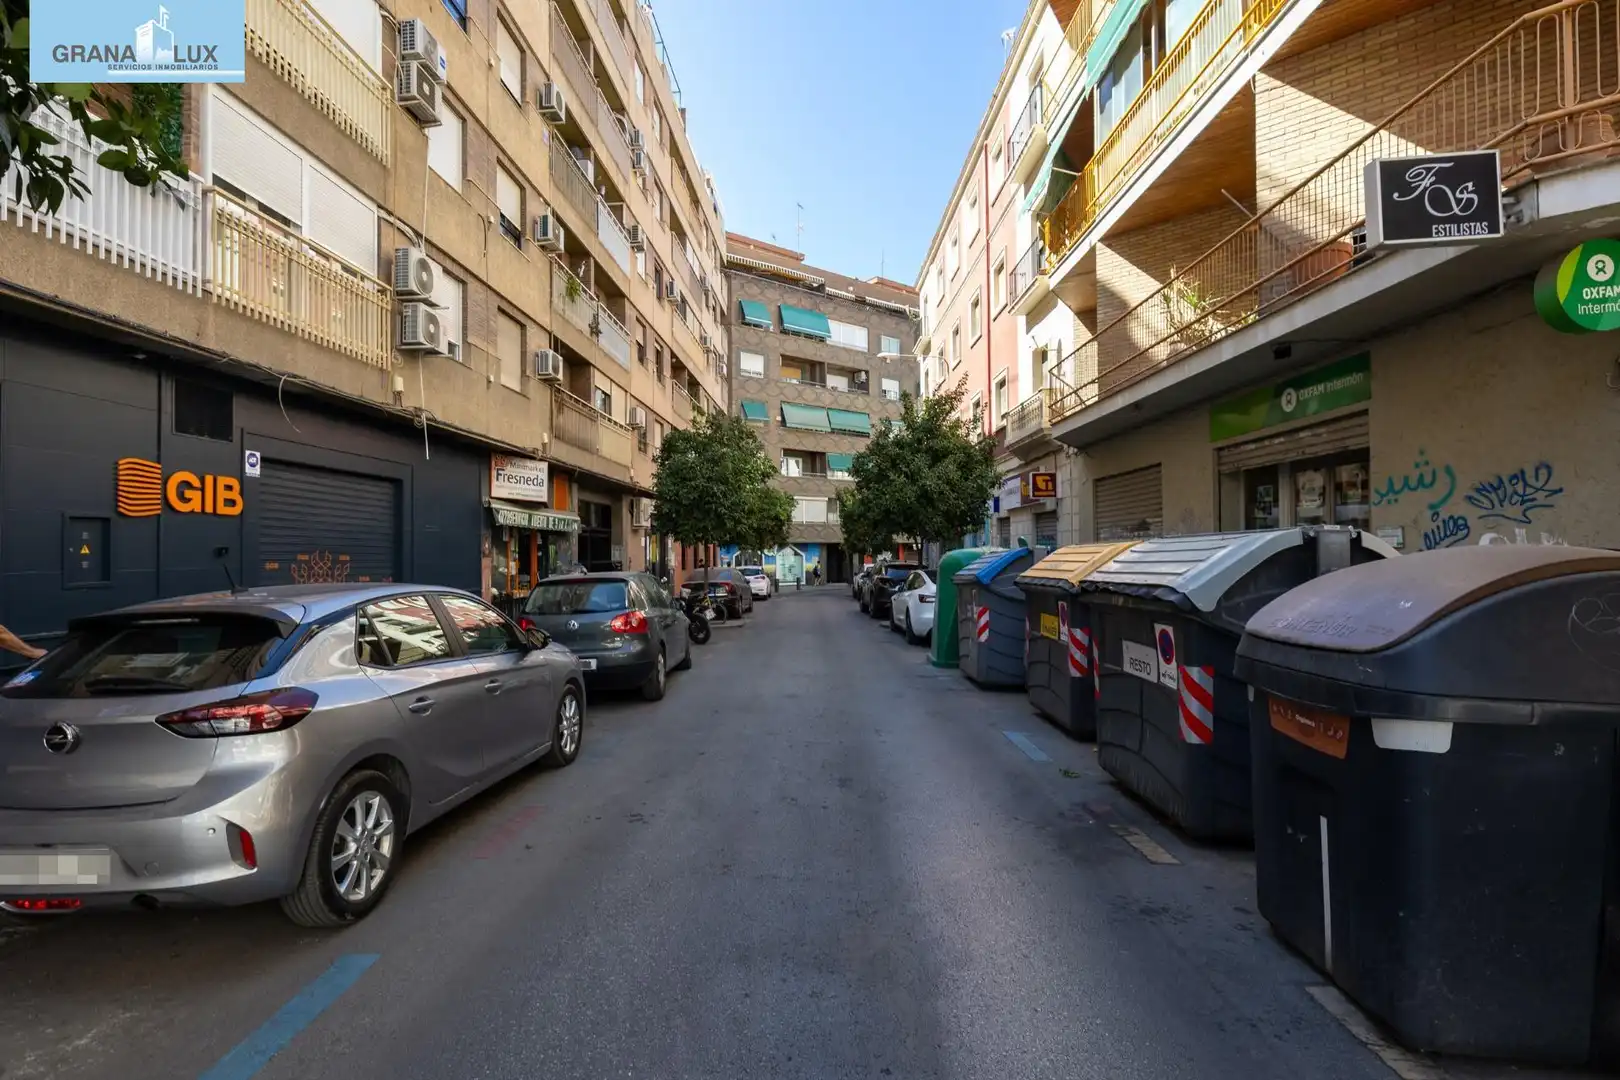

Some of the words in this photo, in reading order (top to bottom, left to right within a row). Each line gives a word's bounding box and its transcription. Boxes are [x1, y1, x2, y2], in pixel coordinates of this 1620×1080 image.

[1432, 221, 1489, 238] ESTILISTAS
[1299, 382, 1325, 401] OXFAM
[1326, 371, 1364, 393] Intermón
[509, 460, 545, 473] Minimarket
[495, 467, 545, 488] Fresneda
[166, 470, 244, 517] GIB
[1129, 657, 1152, 676] RESTO
